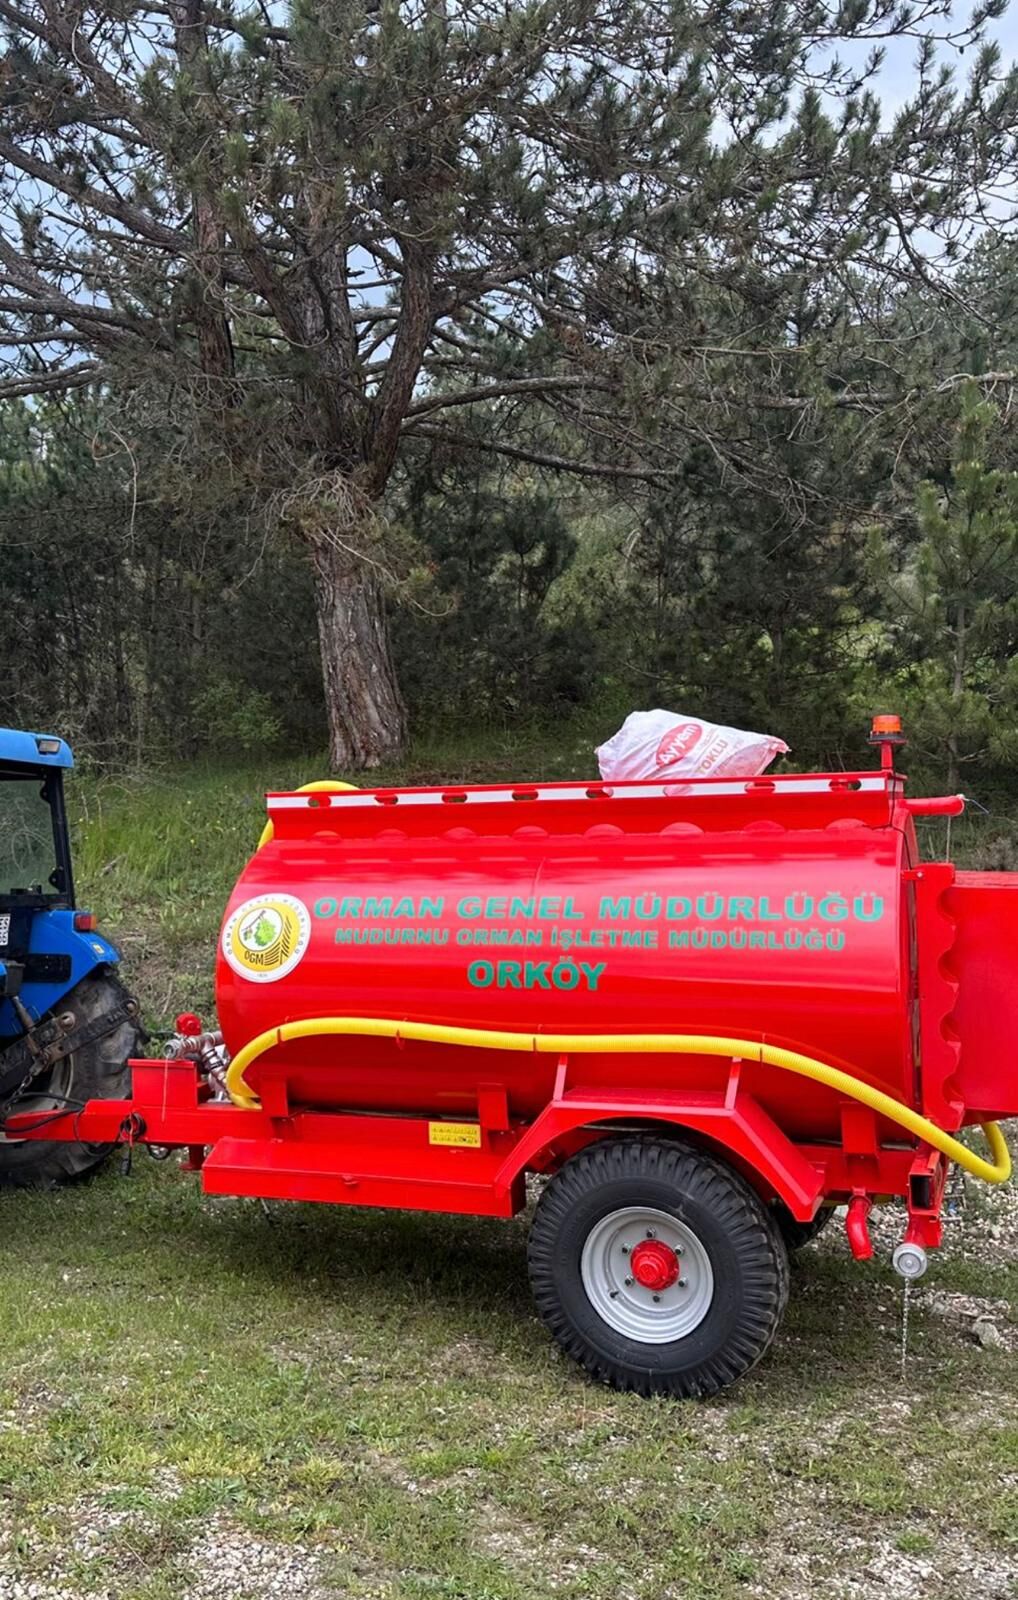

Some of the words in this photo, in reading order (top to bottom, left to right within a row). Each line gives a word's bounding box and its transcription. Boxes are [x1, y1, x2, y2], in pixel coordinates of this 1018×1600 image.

[314, 896, 444, 919] ORMAN
[456, 896, 584, 921] GENEL
[599, 892, 884, 922] MÜDÜRLÜĞÜ
[335, 928, 448, 945] MUDURNU
[456, 929, 543, 946] ORMAN
[550, 927, 658, 950] İŞLETME
[668, 926, 846, 951] MÜDÜRLÜĞÜ
[244, 950, 264, 966] OGM
[467, 957, 607, 991] ORKÖY
